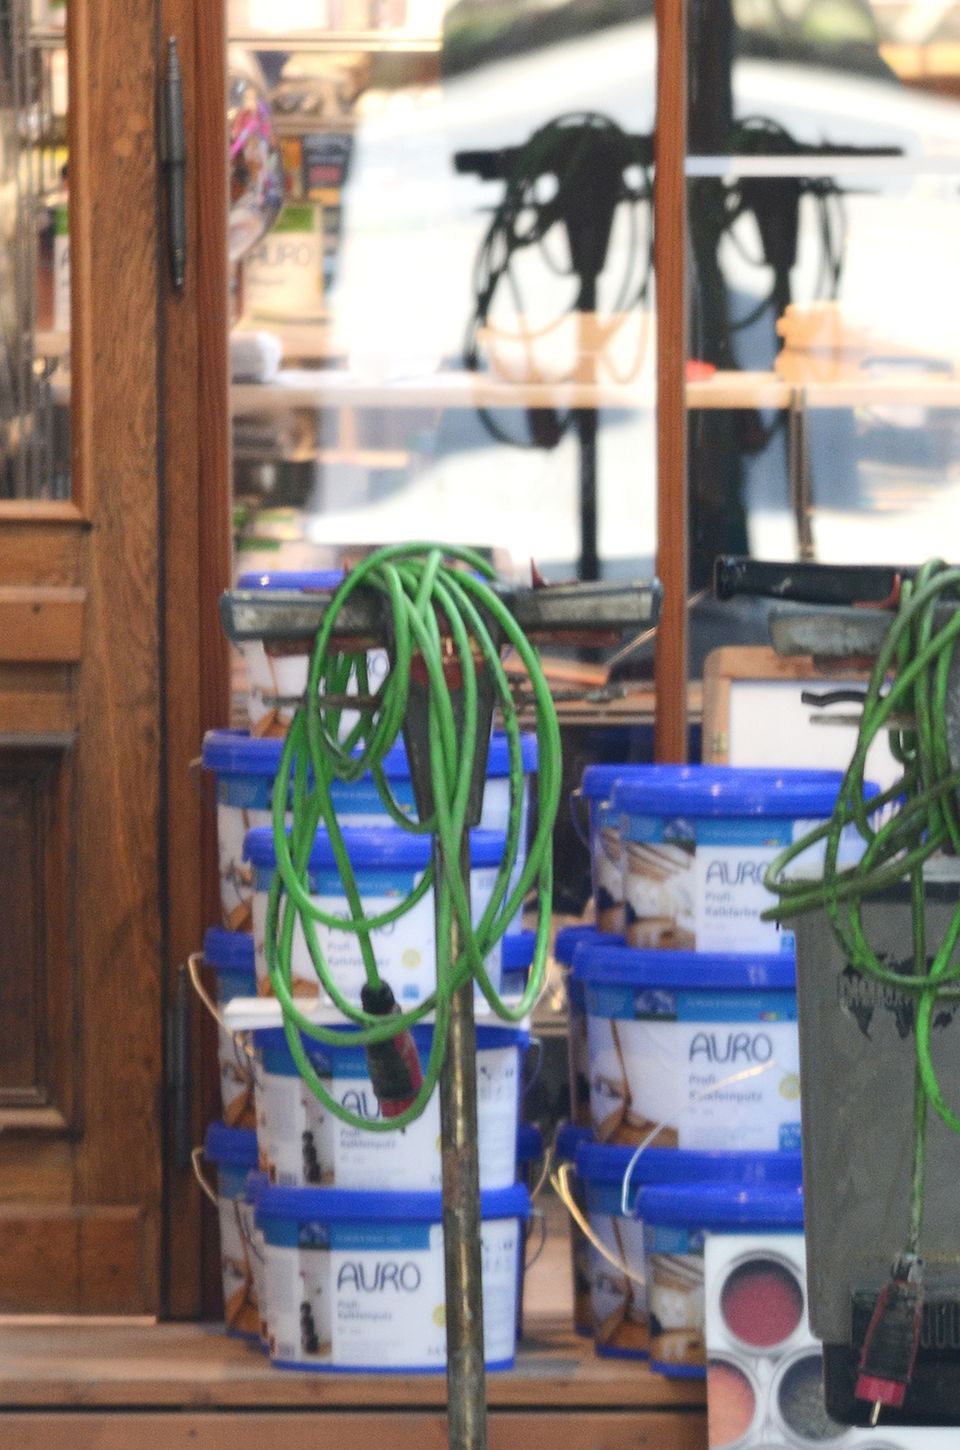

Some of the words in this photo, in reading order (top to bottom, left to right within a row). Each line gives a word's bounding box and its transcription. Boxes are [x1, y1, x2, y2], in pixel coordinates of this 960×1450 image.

[688, 1032, 773, 1063] AURO
[341, 1089, 381, 1121] AU
[336, 1261, 422, 1293] AURO
